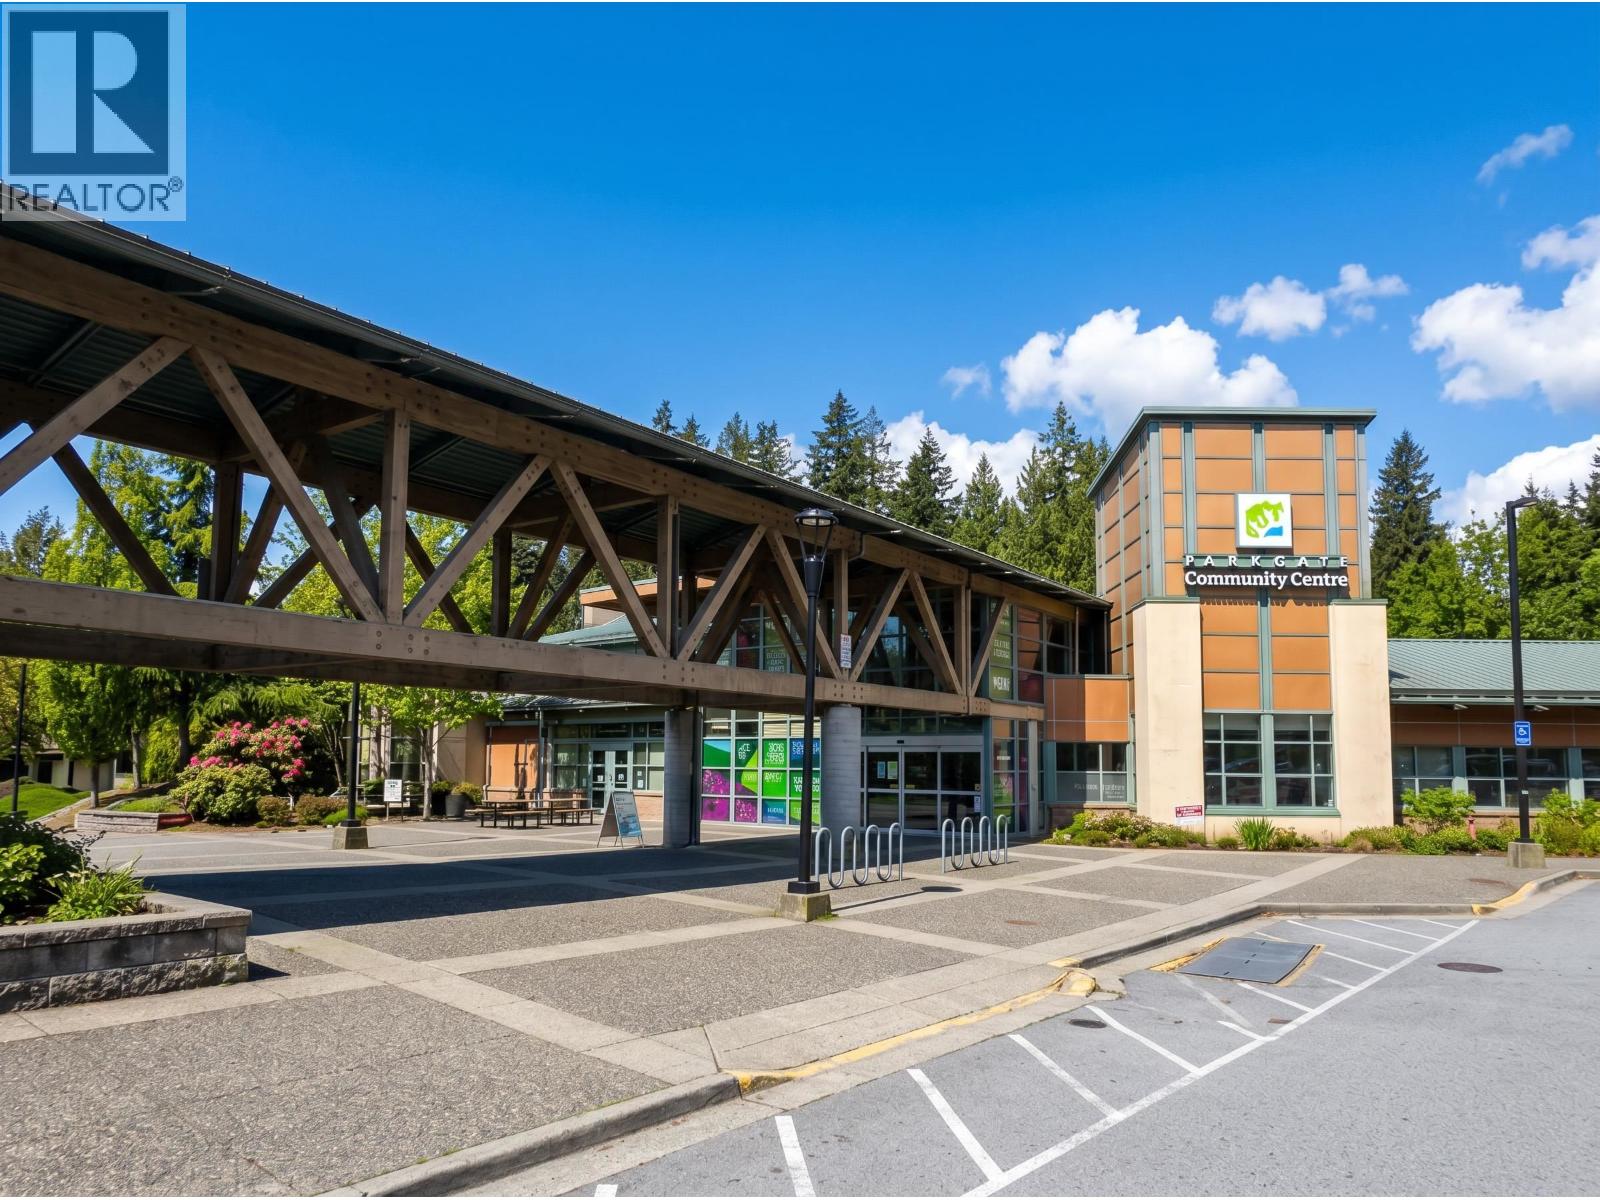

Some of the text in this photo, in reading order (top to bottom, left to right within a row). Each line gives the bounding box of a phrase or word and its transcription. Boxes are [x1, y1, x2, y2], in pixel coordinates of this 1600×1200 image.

[1185, 555, 1348, 567] PARKGATE
[1184, 571, 1348, 590] Community Centre
